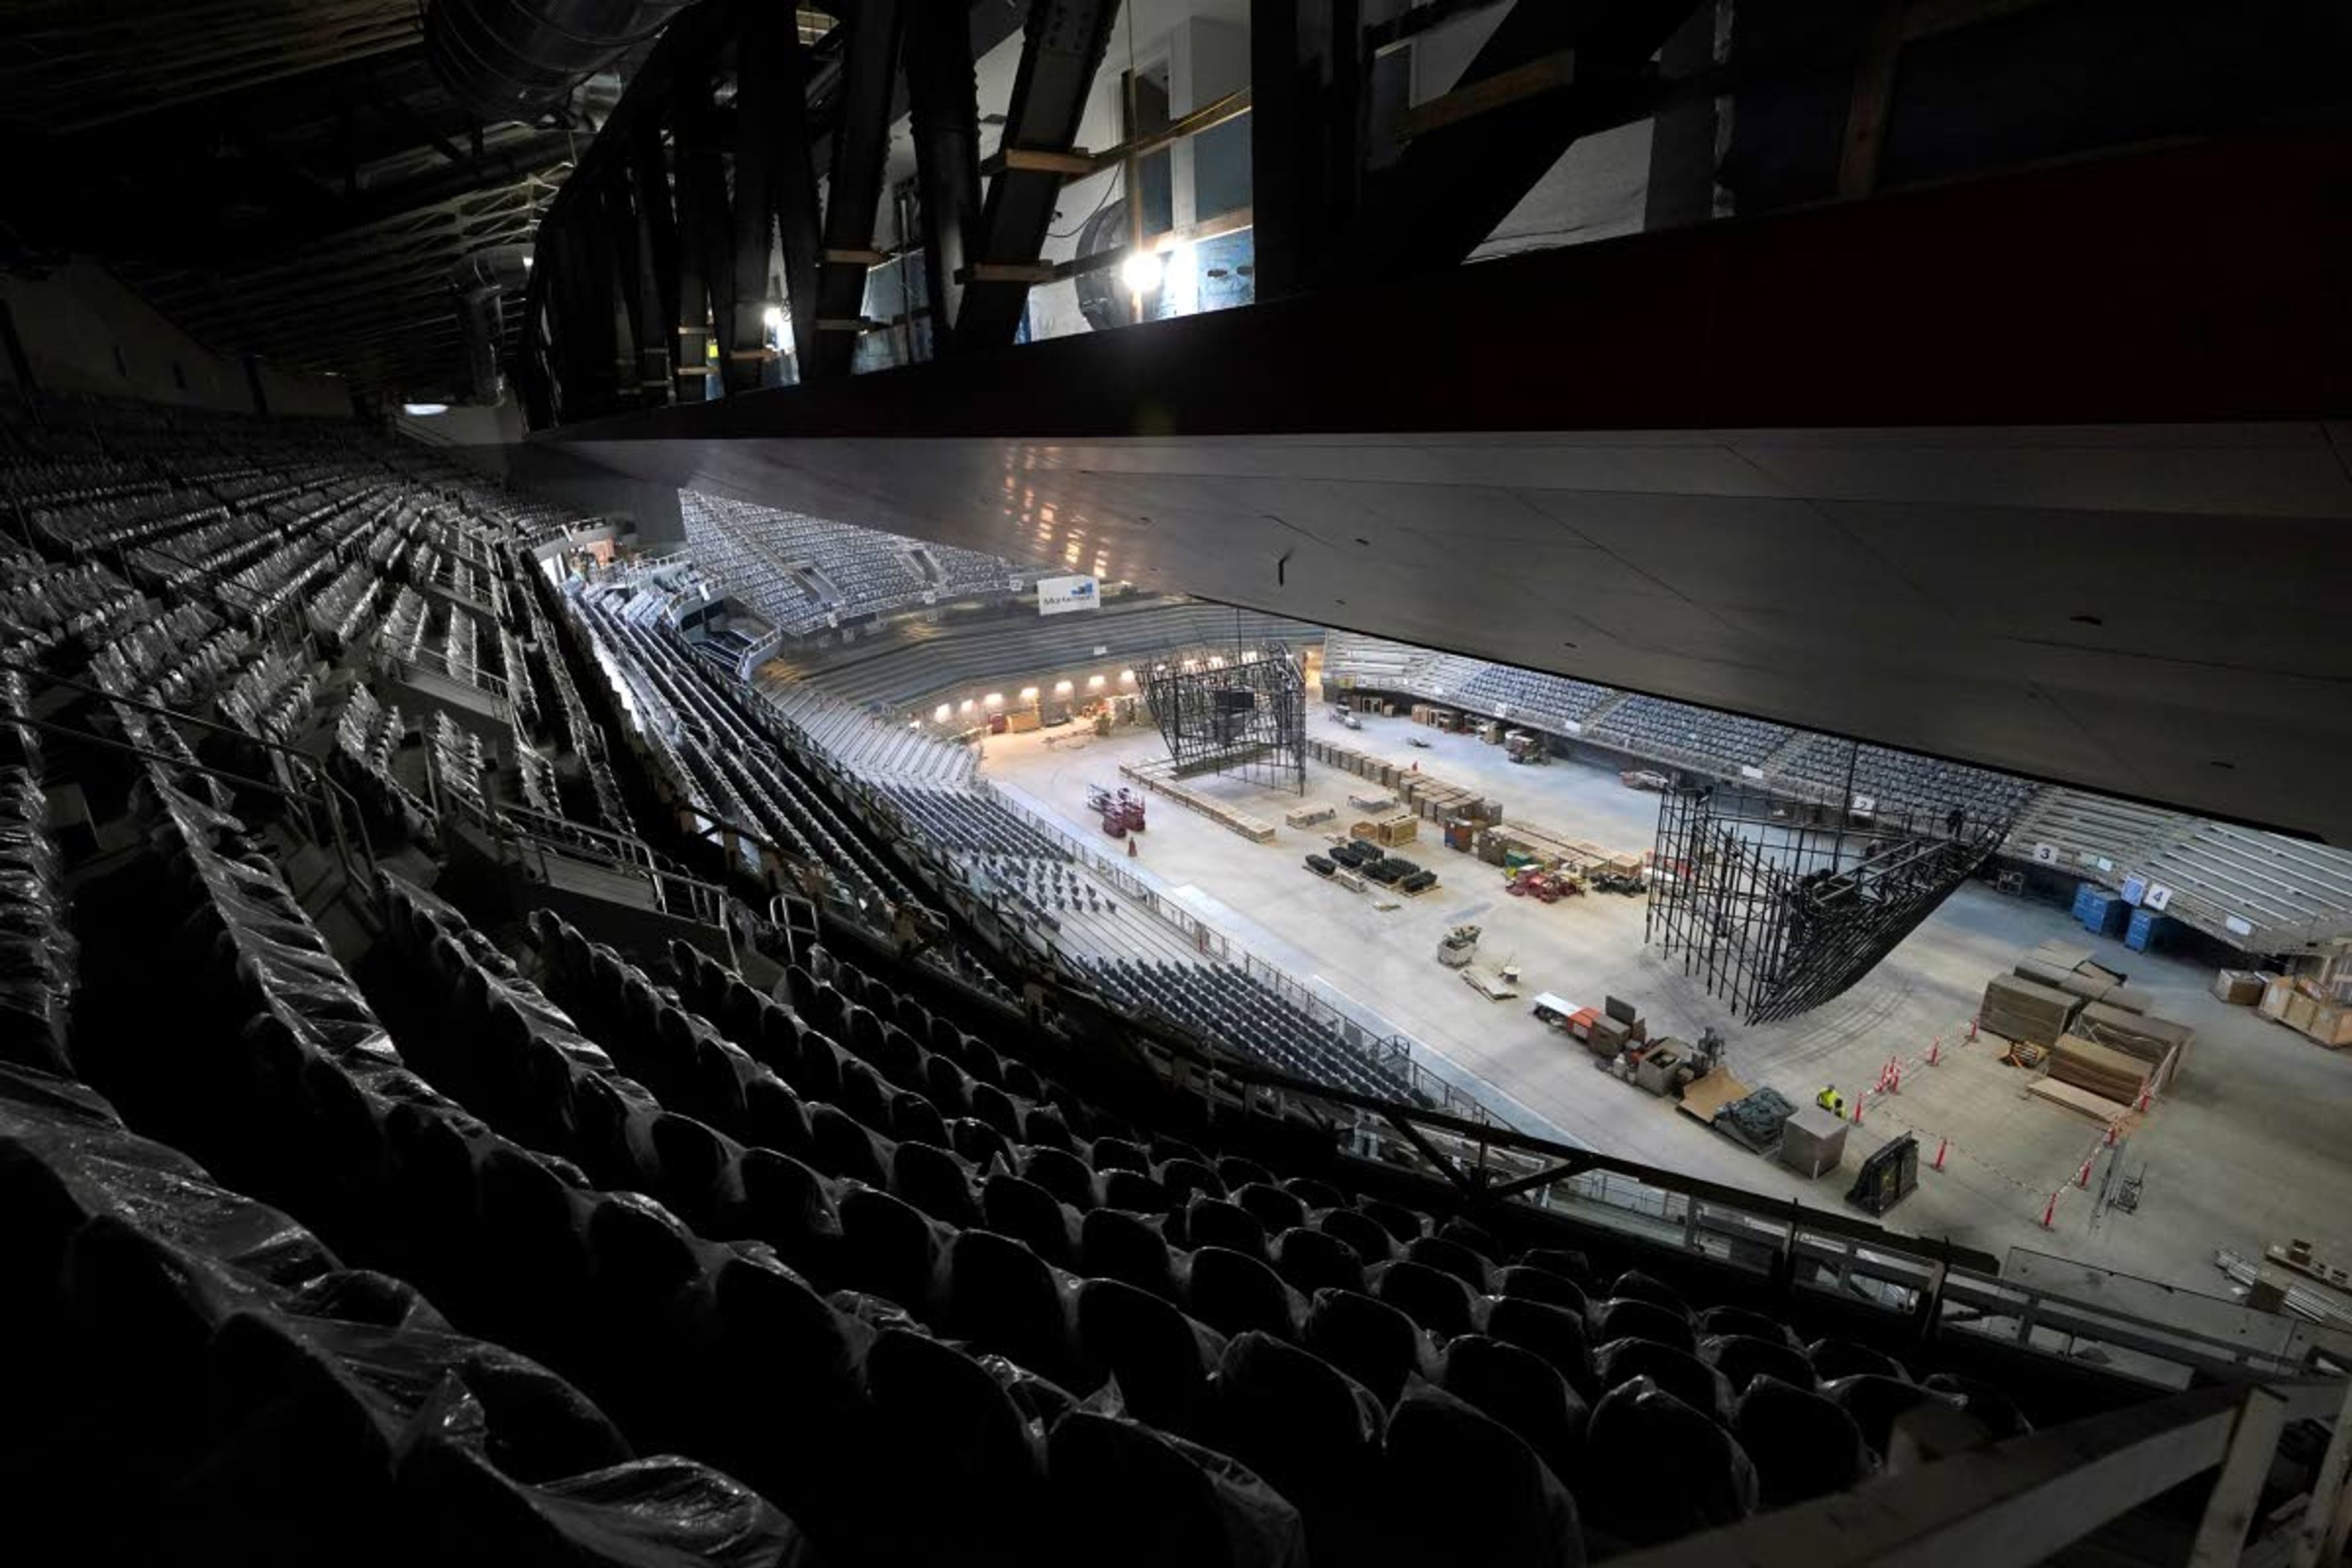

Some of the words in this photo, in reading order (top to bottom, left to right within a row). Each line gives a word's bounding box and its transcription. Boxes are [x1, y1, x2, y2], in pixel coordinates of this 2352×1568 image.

[1860, 800, 1868, 810] 2
[2040, 848, 2051, 859] 3
[2153, 891, 2163, 902] 4
